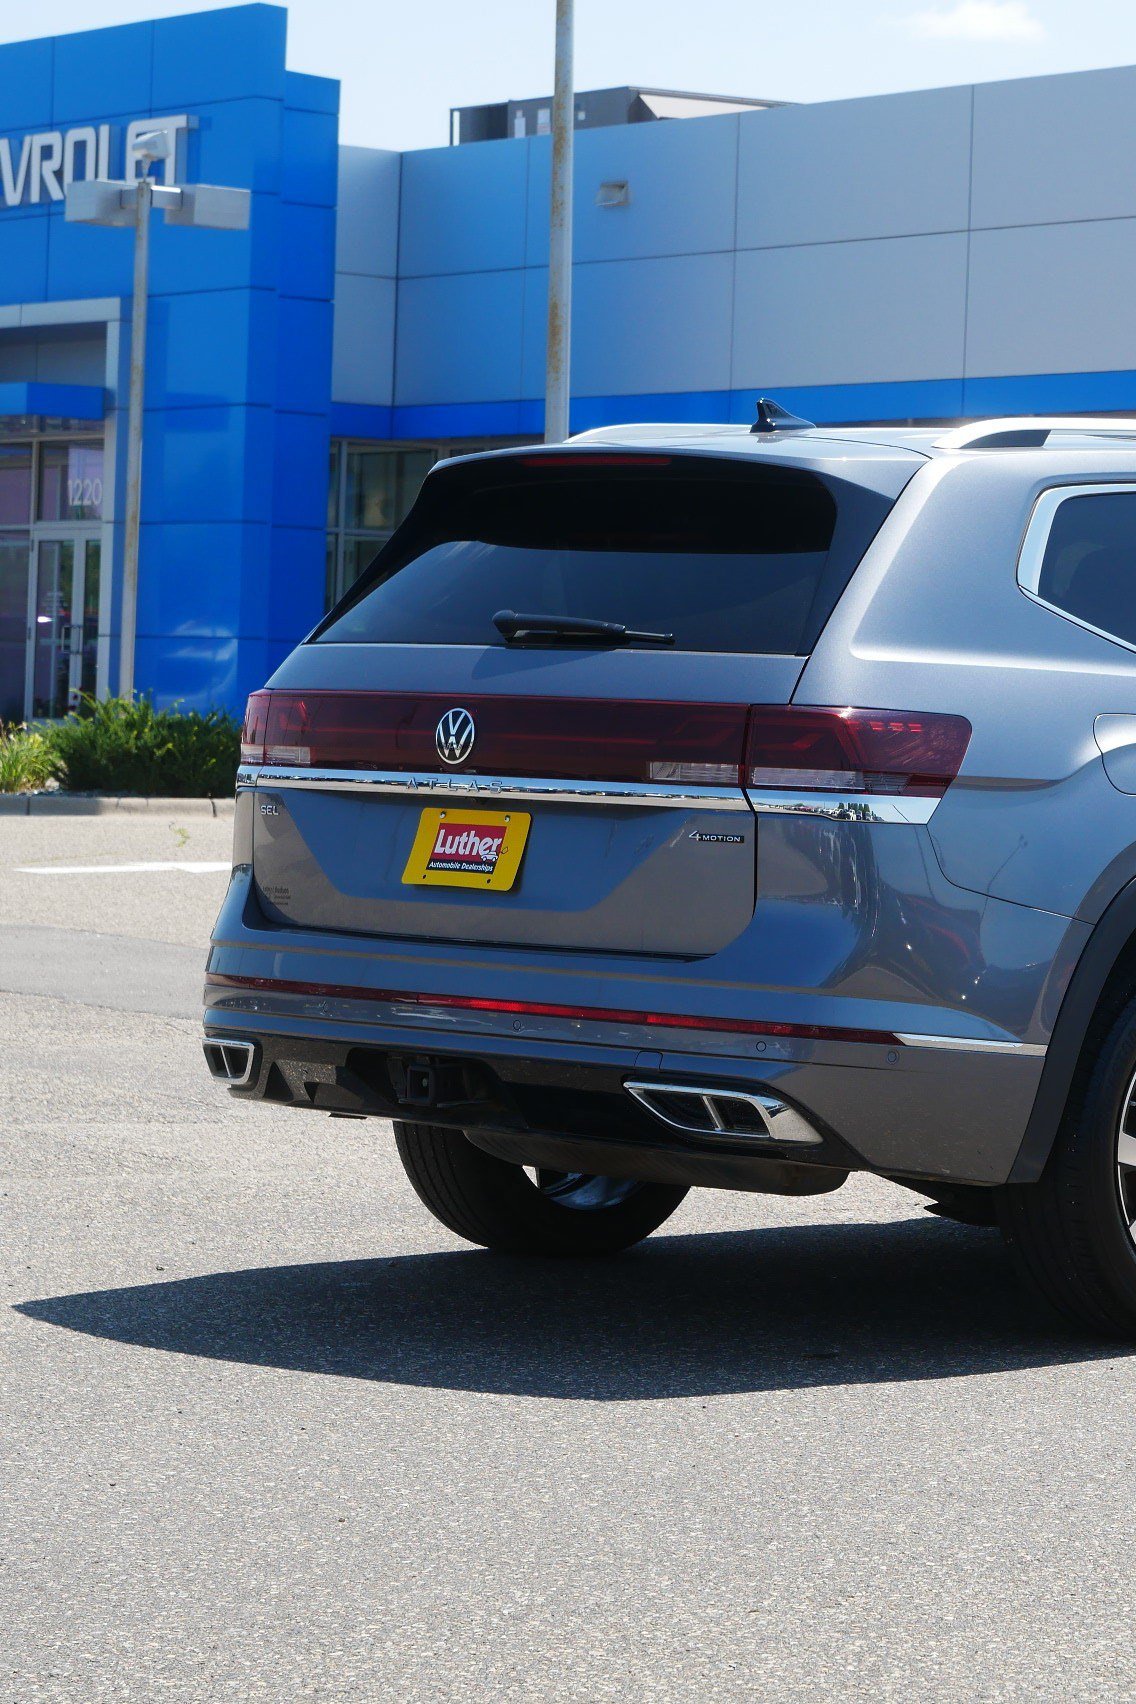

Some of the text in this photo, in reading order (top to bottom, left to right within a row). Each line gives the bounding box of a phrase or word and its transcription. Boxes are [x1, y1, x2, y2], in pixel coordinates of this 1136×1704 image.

[67, 478, 102, 506] 1220
[406, 776, 503, 794] ATLAS
[260, 805, 279, 816] SEL
[434, 829, 503, 856] Luther
[428, 861, 494, 873] Automobile Dealerships
